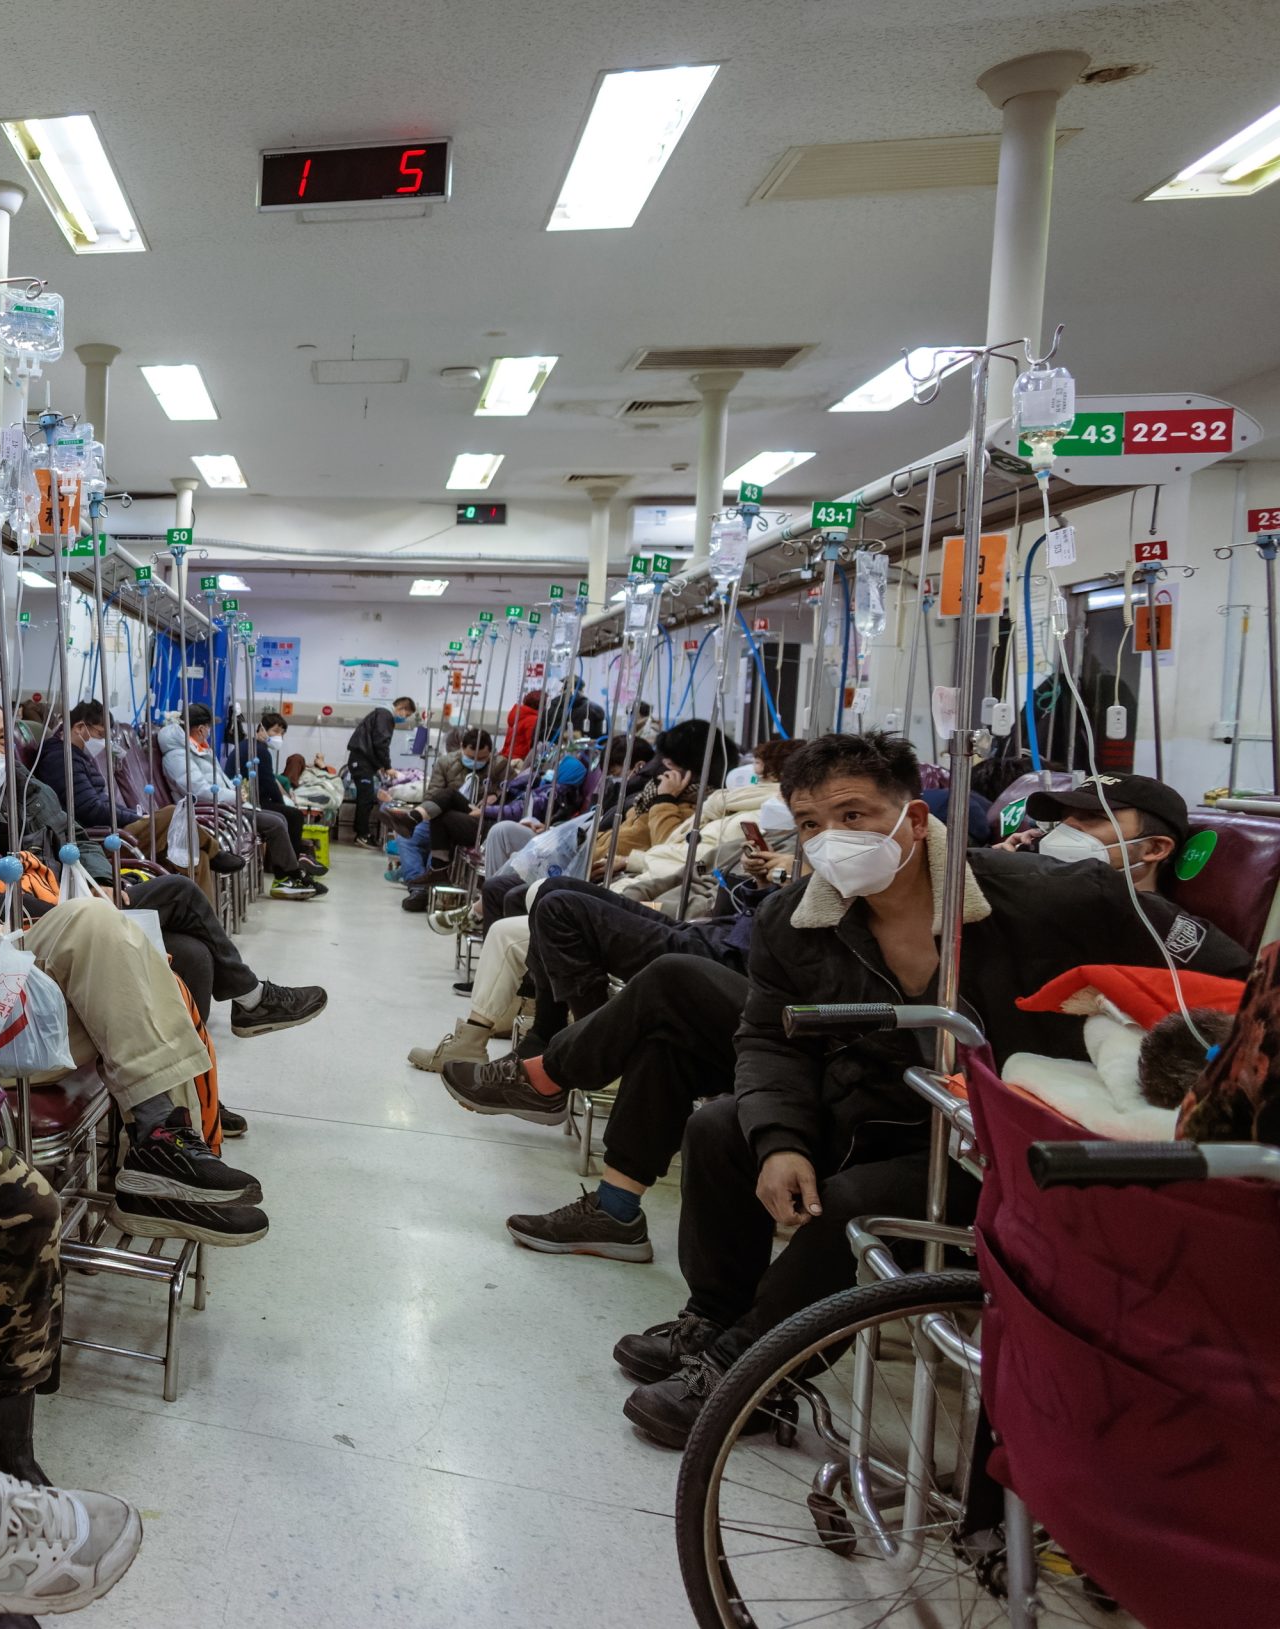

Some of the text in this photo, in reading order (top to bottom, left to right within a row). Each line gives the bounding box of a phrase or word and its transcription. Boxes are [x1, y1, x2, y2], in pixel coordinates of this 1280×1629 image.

[298, 150, 427, 198] 1 5
[1063, 421, 1227, 444] -43 22-32
[745, 486, 758, 499] 43
[817, 507, 852, 523] 43+1
[172, 531, 188, 541] 50
[1142, 544, 1162, 557] 24
[636, 560, 645, 570] 41
[656, 557, 668, 570] 42
[140, 568, 148, 577] 51
[204, 578, 214, 587] 52
[226, 601, 235, 609] 53
[1003, 806, 1023, 825] 43
